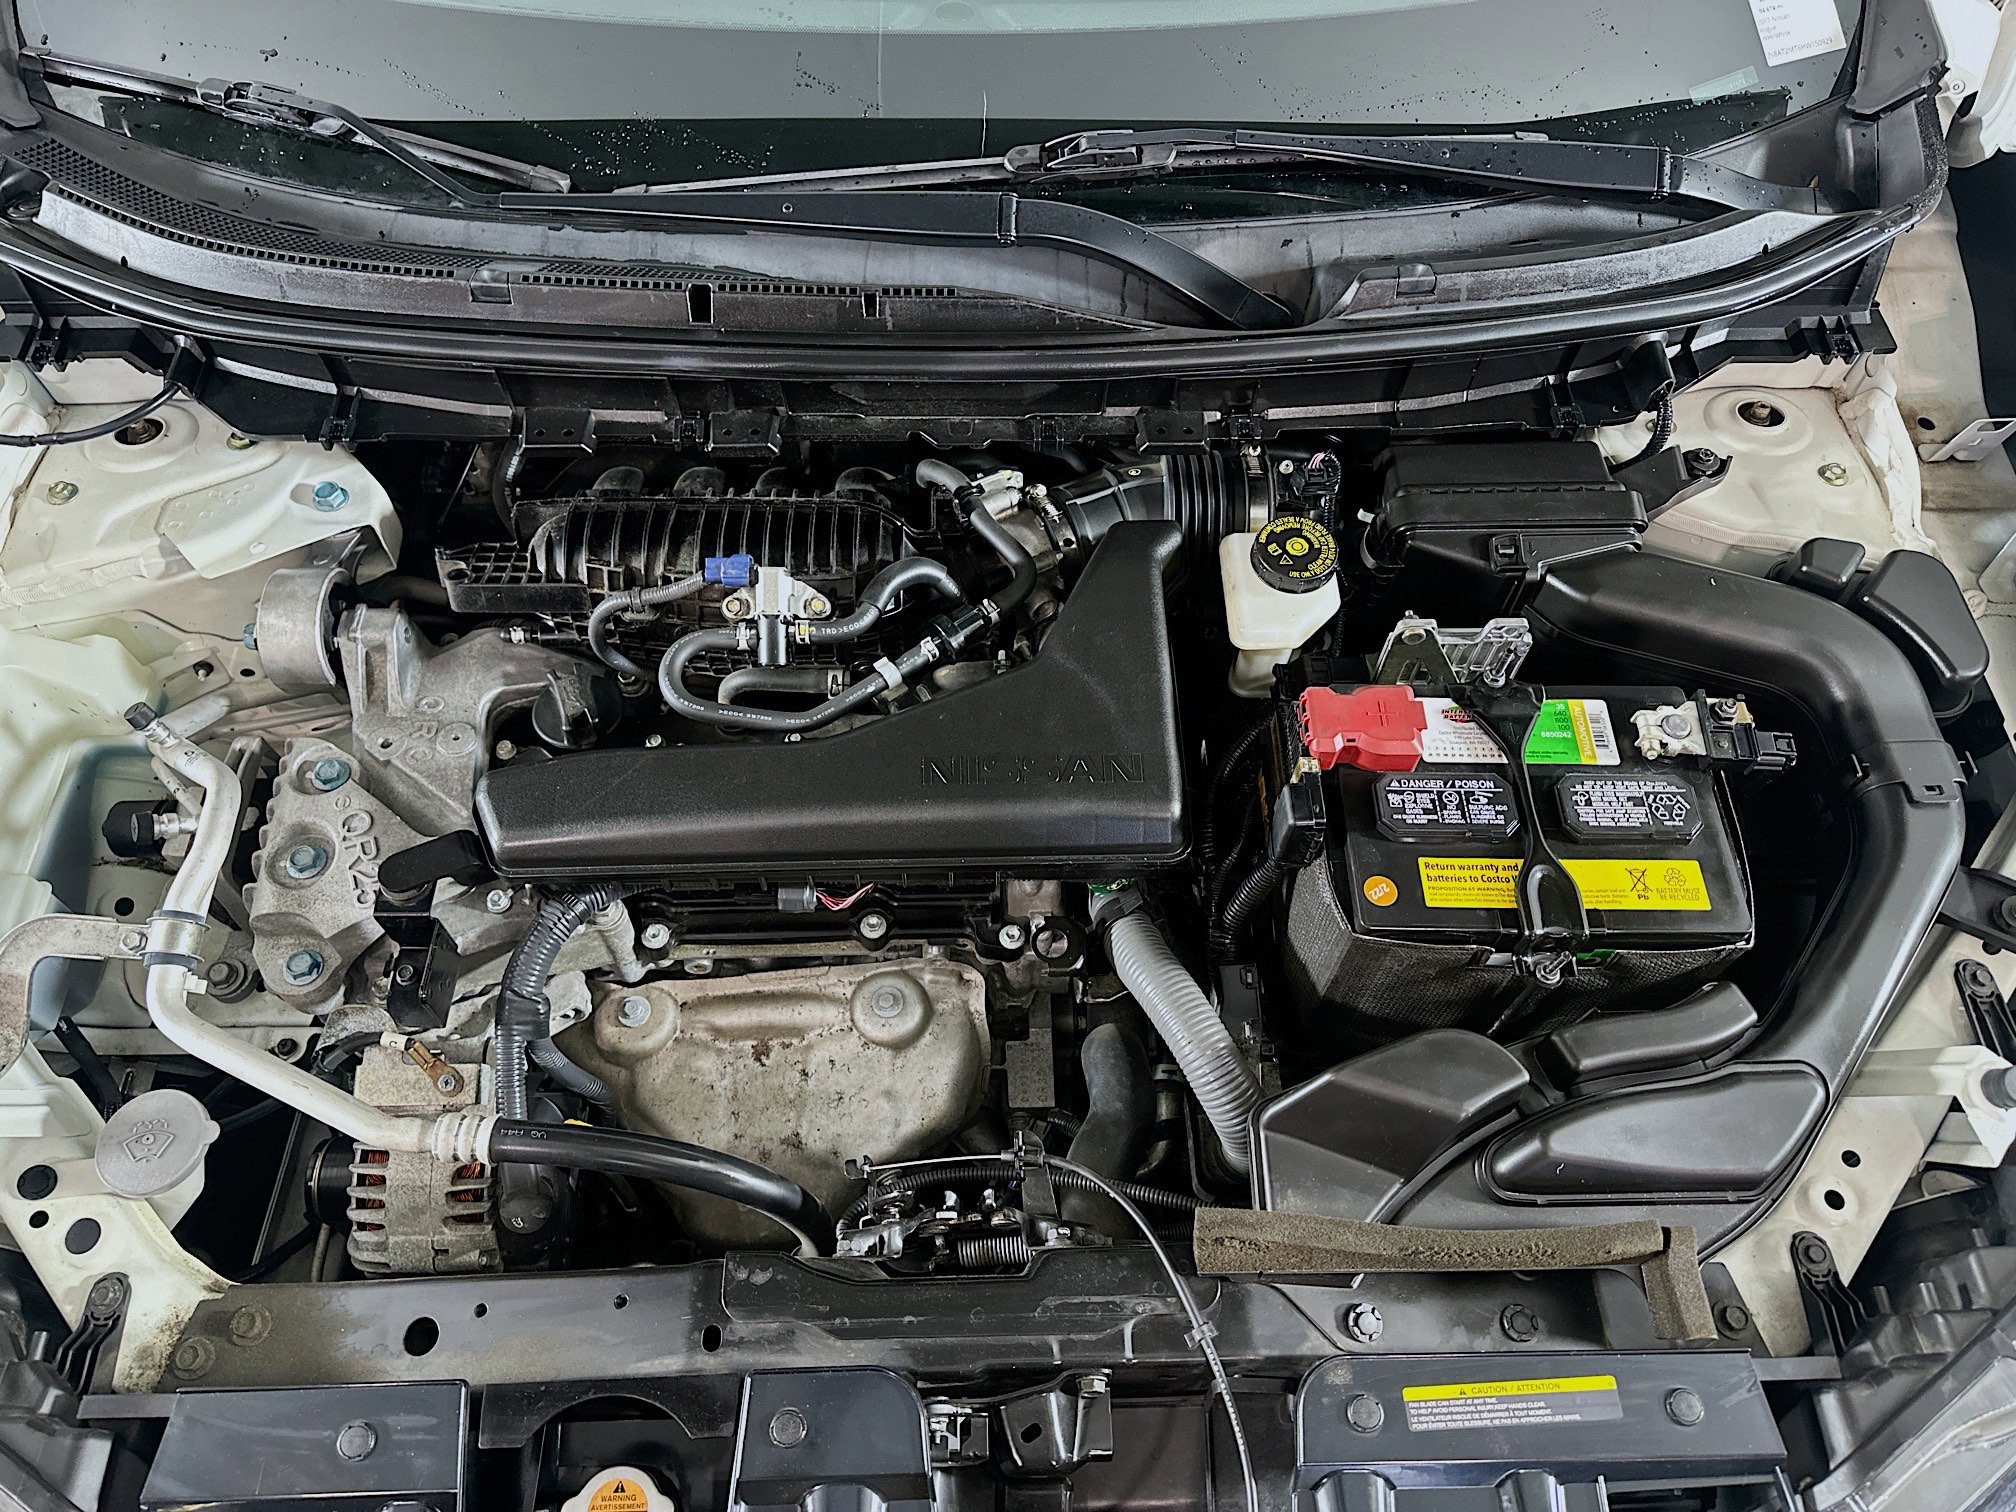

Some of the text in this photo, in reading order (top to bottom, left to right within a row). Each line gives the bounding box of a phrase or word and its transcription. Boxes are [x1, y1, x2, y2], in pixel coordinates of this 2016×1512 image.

[1573, 706, 1593, 758] AUTOMOTIVE
[922, 754, 1144, 784] NISSAN
[1401, 780, 1494, 788] DANGER / POISON
[339, 809, 380, 909] QR25
[1424, 862, 1519, 873] Return warranty and
[1427, 875, 1467, 883] batteries
[1481, 875, 1510, 883] Costco
[1369, 883, 1390, 900] 2/22
[1472, 1386, 1507, 1395] CAUTION
[1517, 1383, 1560, 1391] ATTENTION
[591, 1503, 645, 1511] AVERTISSEMENT
